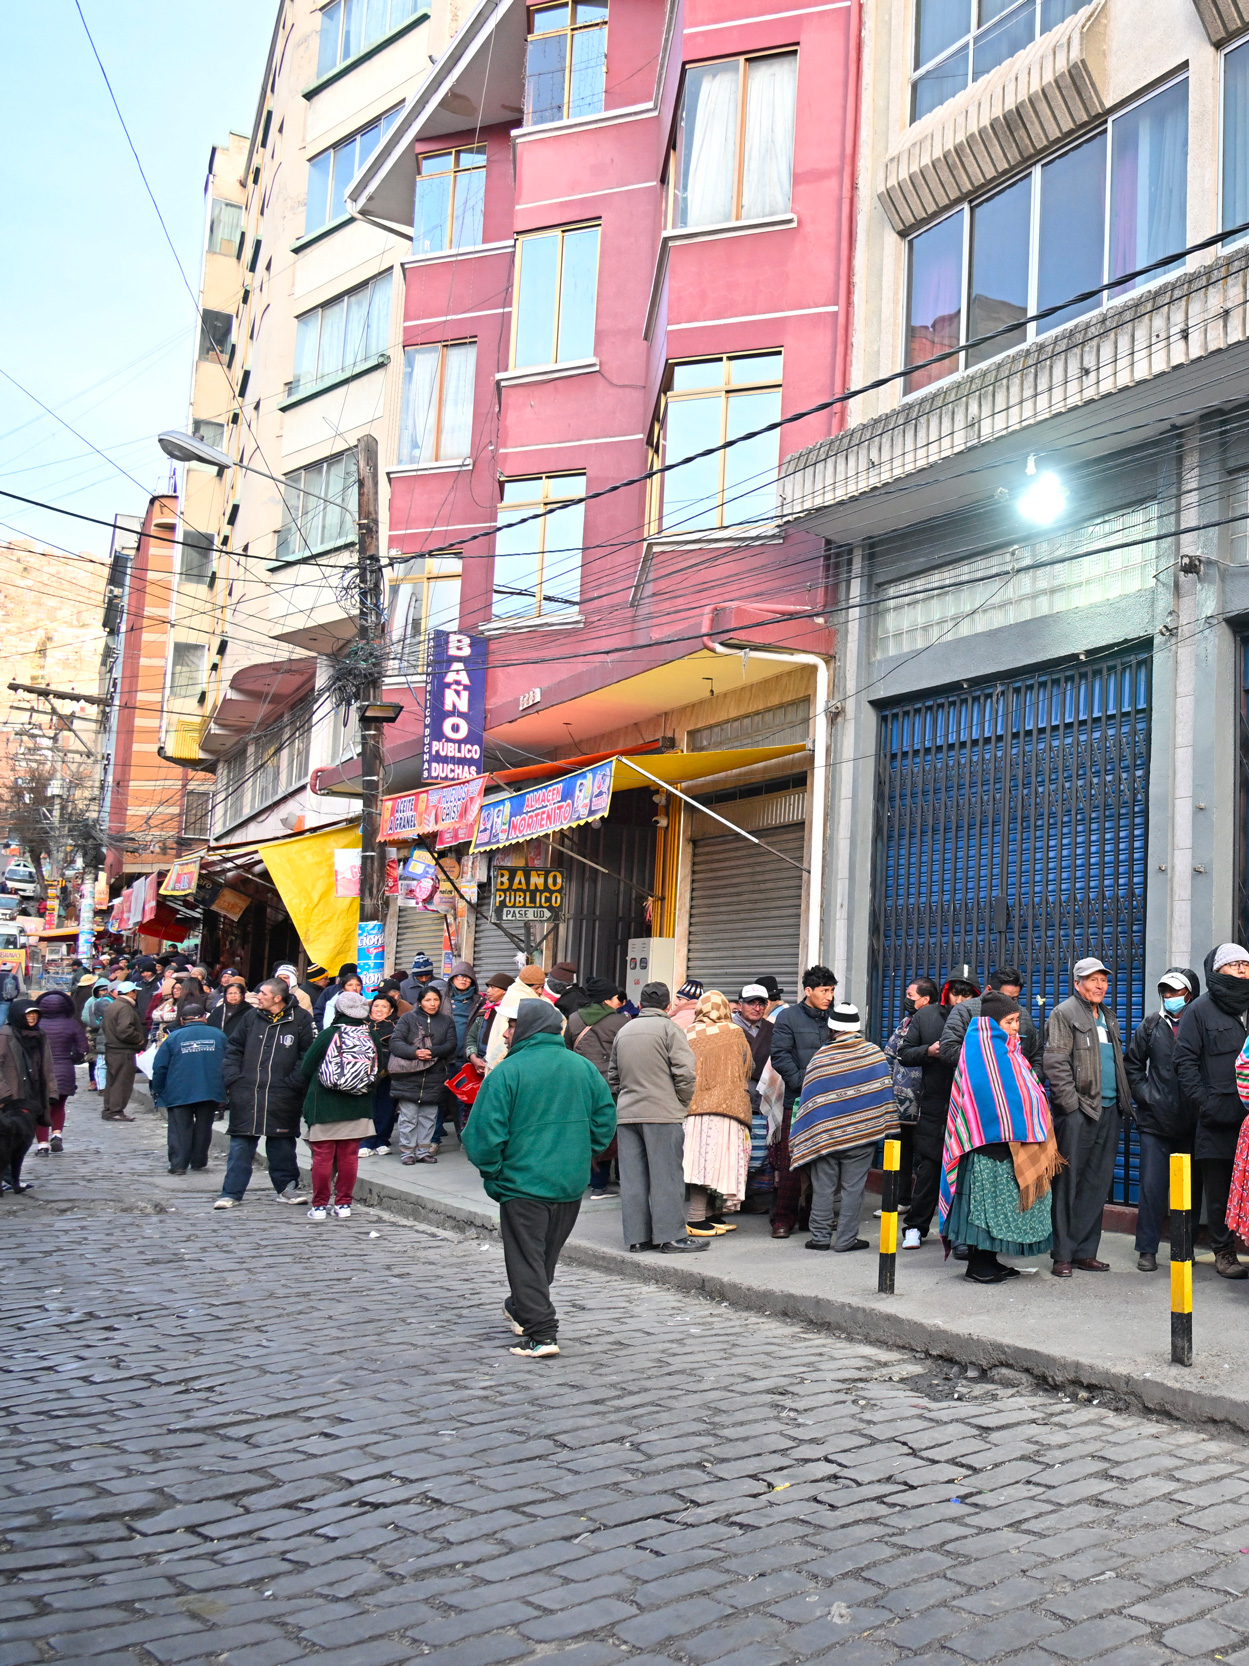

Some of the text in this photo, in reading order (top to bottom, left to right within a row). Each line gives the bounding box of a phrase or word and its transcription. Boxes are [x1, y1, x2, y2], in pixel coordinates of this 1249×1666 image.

[442, 634, 471, 740] BAÑO
[432, 738, 480, 760] PÚBLICO
[431, 762, 477, 780] DUCHAS
[395, 797, 415, 814] ACEITE
[441, 783, 469, 806] HUEVOS
[523, 783, 563, 812] ALMACEN
[387, 812, 416, 833] A GRANEL
[496, 869, 563, 891] BAÑO
[505, 909, 548, 919] PASE UD.
